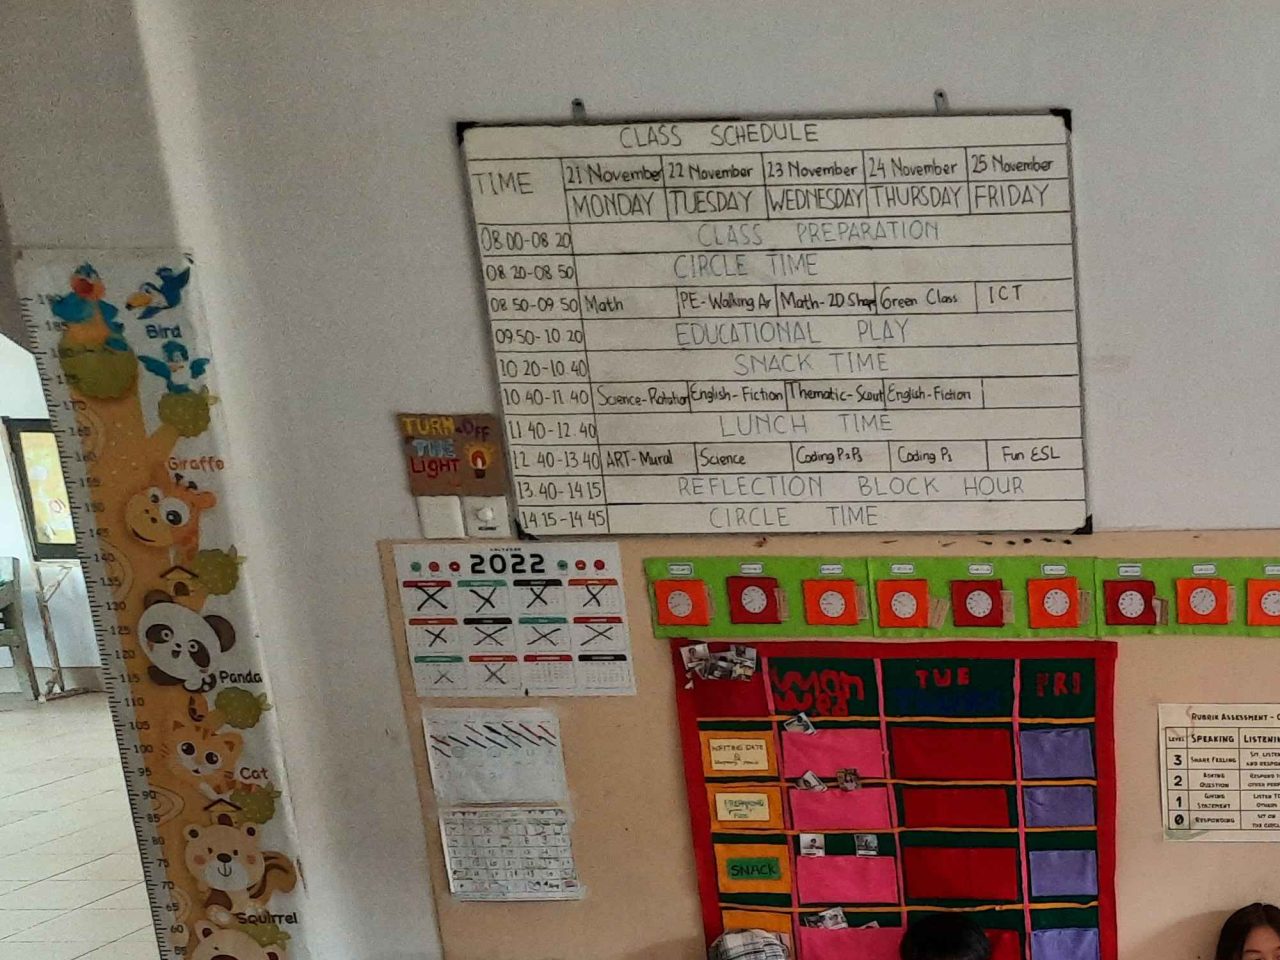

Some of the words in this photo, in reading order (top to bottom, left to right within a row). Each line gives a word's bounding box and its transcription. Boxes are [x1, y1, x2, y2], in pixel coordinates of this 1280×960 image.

[620, 124, 682, 148] CLASS
[711, 123, 818, 146] SCHEDULE
[668, 162, 684, 179] 22
[688, 163, 753, 180] November
[767, 162, 784, 177] 23
[788, 162, 857, 178] November
[868, 157, 886, 179] 24
[892, 155, 957, 176] November
[971, 154, 988, 173] 25
[992, 154, 1054, 173] November
[566, 162, 582, 184] 21
[589, 164, 663, 184] November
[472, 172, 534, 195] TIME
[572, 191, 655, 218] MONDAY
[669, 188, 752, 214] TUESDAY
[768, 186, 864, 212] WEDNESDAY
[869, 184, 962, 209] THURSDAY
[974, 183, 1049, 210] FRIDAY
[699, 222, 763, 247] CLASS
[798, 220, 939, 244] PREPARATION
[674, 254, 748, 280] CIRCLE
[766, 252, 818, 277] TIME
[586, 291, 624, 312] Math
[879, 286, 918, 309] Green
[926, 287, 958, 305] Class
[989, 284, 1023, 304] ICT
[146, 324, 182, 339] Bird
[675, 320, 822, 346] EDUCATIONAL
[858, 318, 910, 343] PLAY
[734, 353, 812, 375] SNACK
[829, 352, 889, 373] TIME
[401, 416, 456, 435] TURN
[720, 413, 808, 437] LUNCH
[839, 412, 893, 434] TIME
[700, 449, 746, 467] Science
[796, 445, 835, 464] Coding
[897, 445, 936, 464] Coding
[1002, 446, 1025, 462] Fun
[1030, 445, 1061, 462] ESL
[168, 456, 225, 471] Giraffe
[678, 475, 823, 497] REFLECTION
[858, 475, 940, 497] BLOCK
[963, 475, 1025, 497] HOUR
[709, 506, 790, 529] CIRCLE
[826, 505, 878, 526] TIME
[469, 553, 545, 575] 2022
[218, 670, 263, 684] Panda
[915, 668, 970, 689] TUE
[129, 721, 150, 730] 105
[1191, 733, 1235, 743] SPEAKING
[133, 744, 153, 754] 100
[1173, 754, 1182, 766] 3
[138, 767, 152, 777] 95
[239, 766, 268, 780] Cat
[1173, 775, 1182, 786] 2
[142, 790, 157, 800] 90
[1175, 796, 1182, 808] 1
[147, 813, 161, 823] 85
[1174, 814, 1184, 825] 0
[152, 836, 165, 845] 80
[156, 858, 170, 868] 75
[731, 863, 777, 876] SNACK
[161, 880, 175, 890] 70
[166, 902, 180, 912] 65
[236, 911, 298, 925] Squirrel
[170, 924, 184, 934] 60
[174, 945, 187, 955] 55
